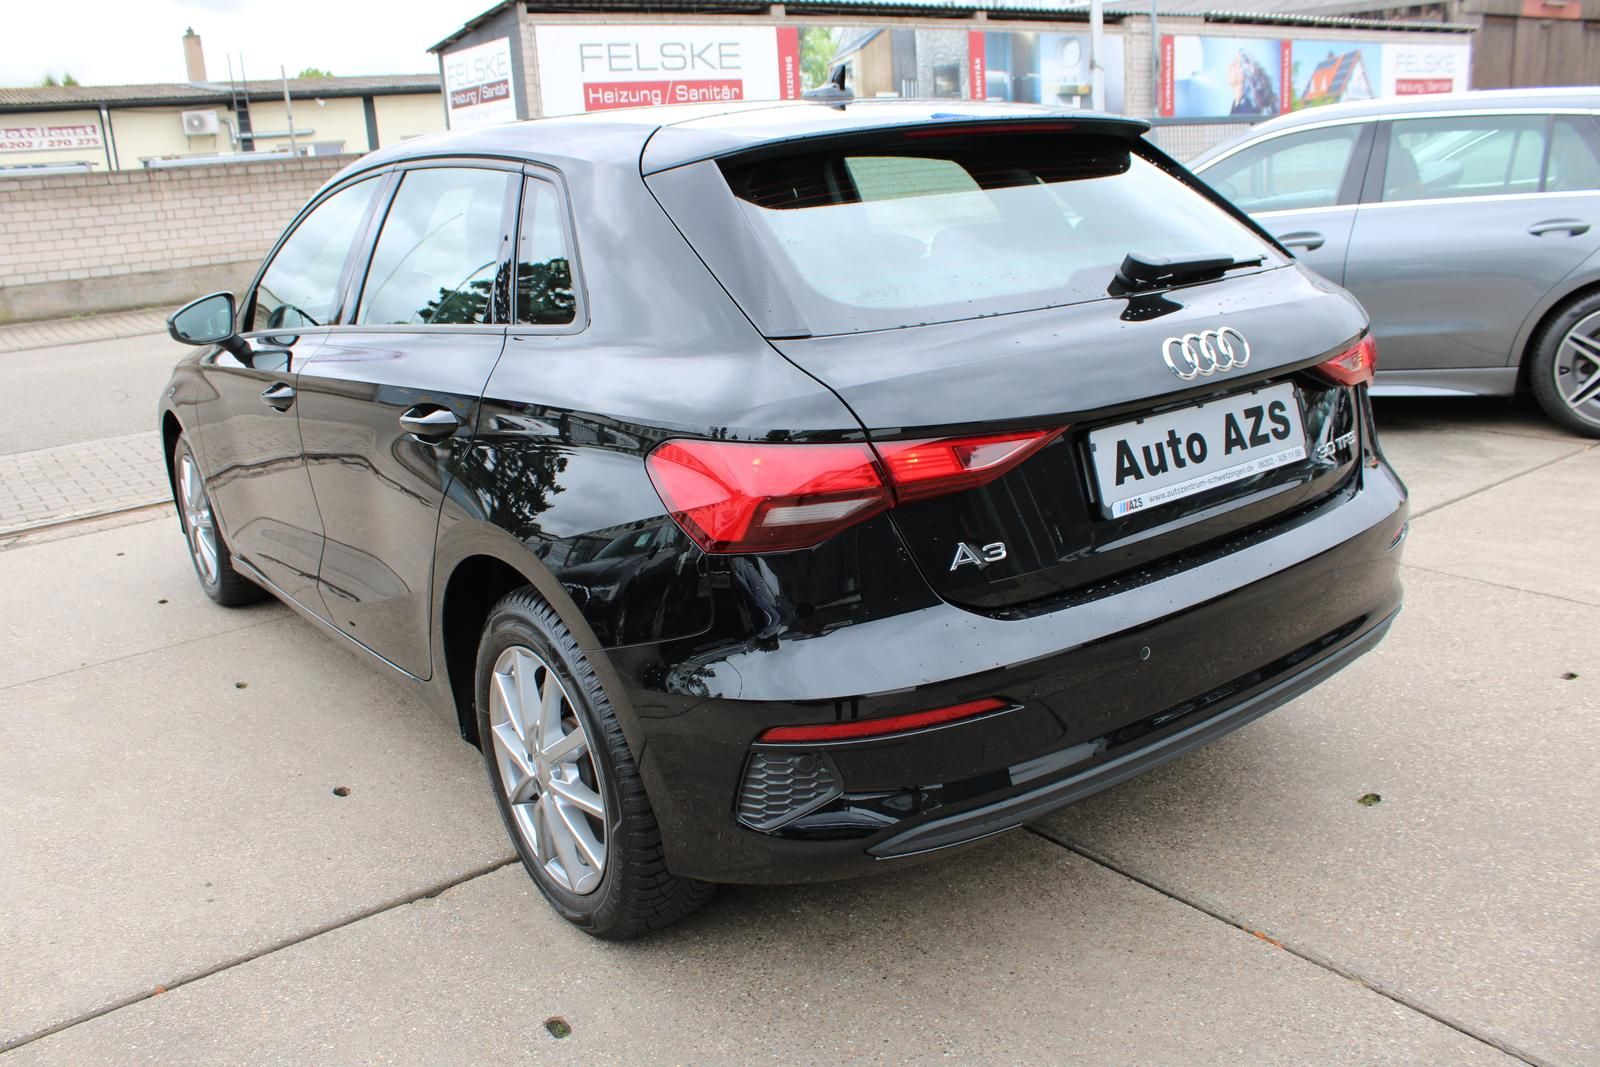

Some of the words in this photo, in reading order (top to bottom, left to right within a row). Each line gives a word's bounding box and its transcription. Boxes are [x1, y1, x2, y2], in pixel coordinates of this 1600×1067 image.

[448, 51, 509, 87] FELSKE
[580, 42, 742, 72] FELSKE
[1396, 54, 1456, 72] FELSKE
[589, 80, 740, 105] Heizung/Sanitär
[48, 138, 72, 147] 270
[78, 138, 99, 146] 275
[1115, 429, 1208, 486] Auto
[1224, 400, 1292, 456] AZS
[1128, 497, 1144, 512] AZS
[1148, 465, 1254, 503] www.autozentrum-schwetzingen.de
[949, 541, 1008, 572] A3
